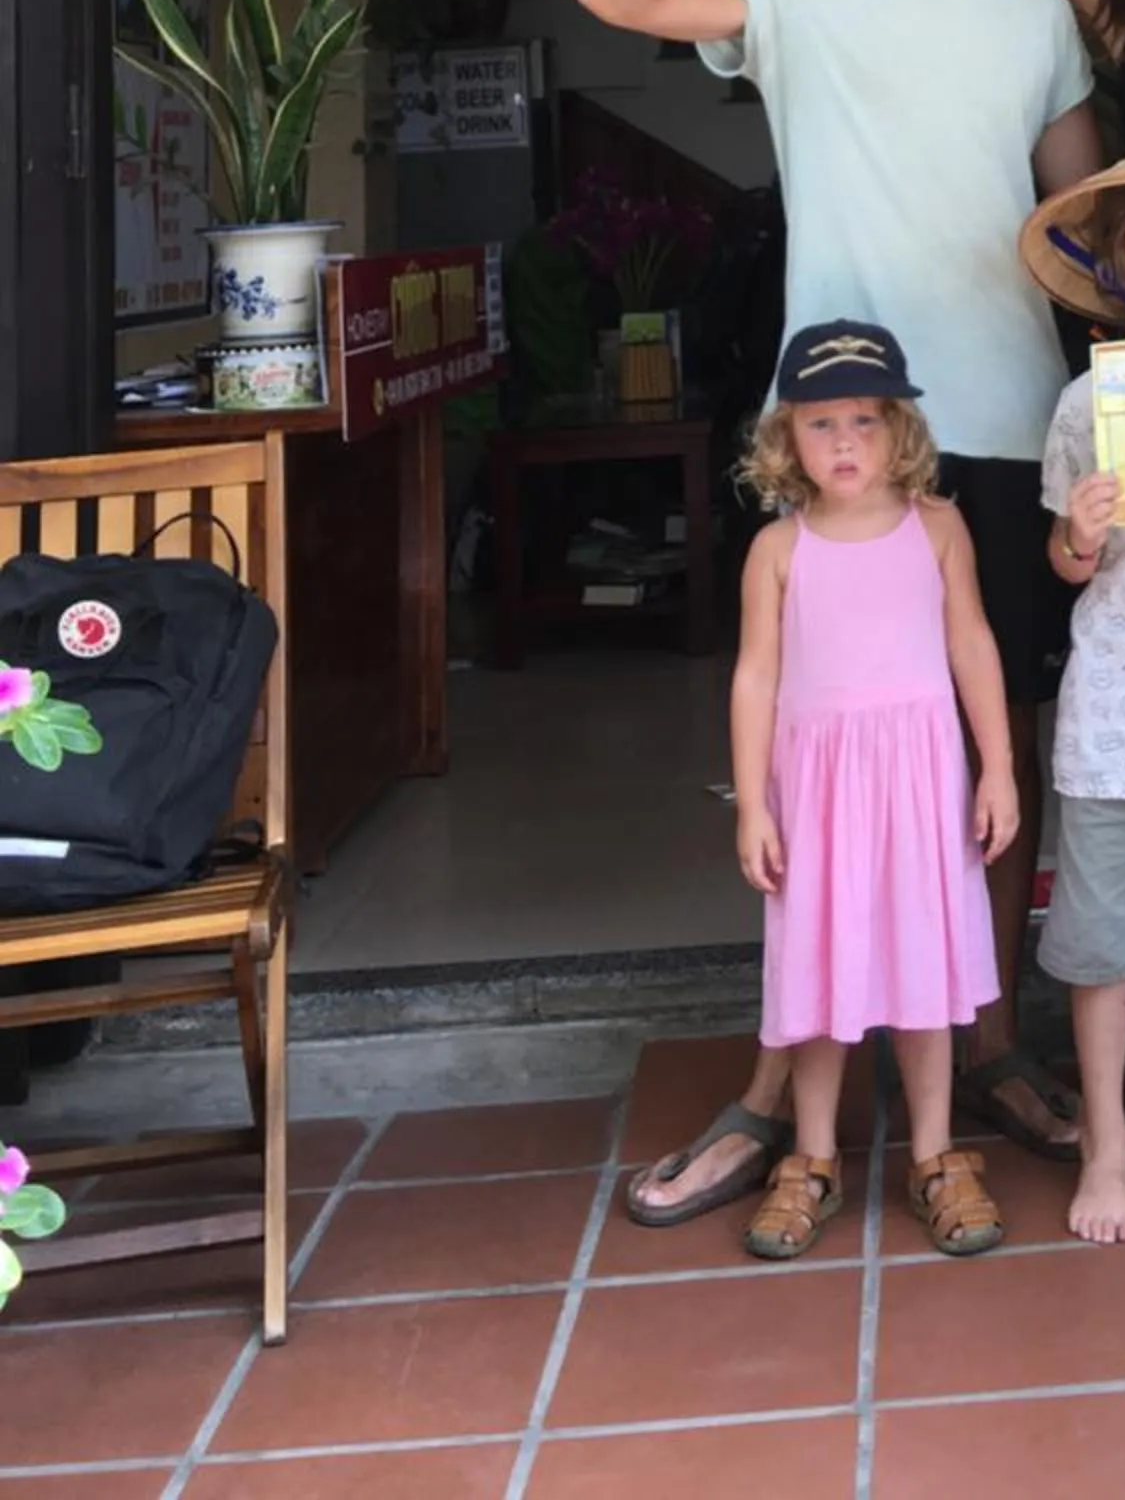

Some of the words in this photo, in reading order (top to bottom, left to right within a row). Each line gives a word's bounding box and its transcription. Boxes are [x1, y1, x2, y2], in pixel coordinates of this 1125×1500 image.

[455, 59, 518, 81] WATER
[455, 88, 506, 109] BEER
[456, 114, 513, 135] DRINK
